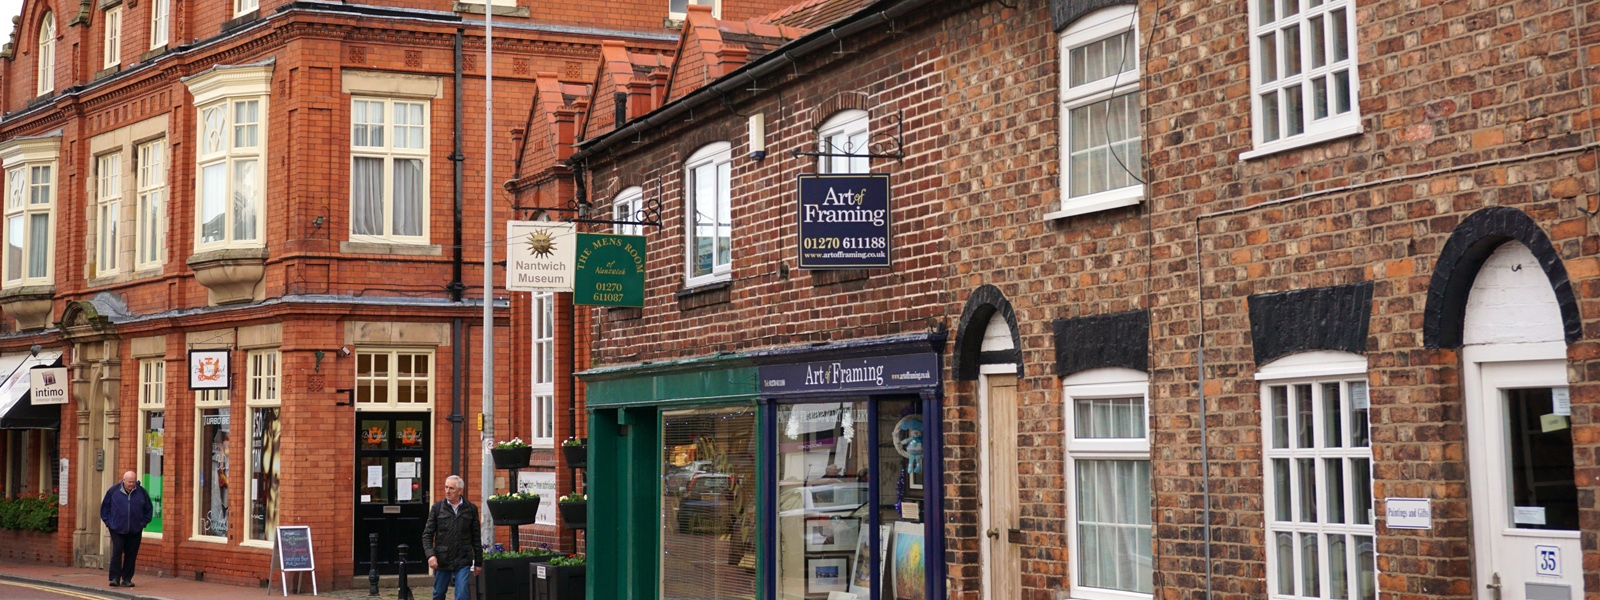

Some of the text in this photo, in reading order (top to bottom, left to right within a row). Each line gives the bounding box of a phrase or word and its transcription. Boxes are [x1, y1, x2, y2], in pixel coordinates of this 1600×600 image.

[822, 187, 867, 206] Art of
[803, 204, 885, 227] Framing
[803, 237, 886, 249] 01270 611188
[577, 237, 644, 273] THE MENS ROOM
[804, 251, 886, 259] www.artofframing.co.uk
[515, 261, 566, 271] Nantwich
[606, 260, 615, 268] of
[518, 273, 565, 284] Museum
[595, 282, 622, 292] 01270
[593, 292, 624, 302] 611087
[805, 360, 884, 385] Art of Framing
[35, 387, 64, 397] intimo
[1388, 507, 1429, 519] Paintings and Gifts
[1540, 550, 1556, 571] 35
